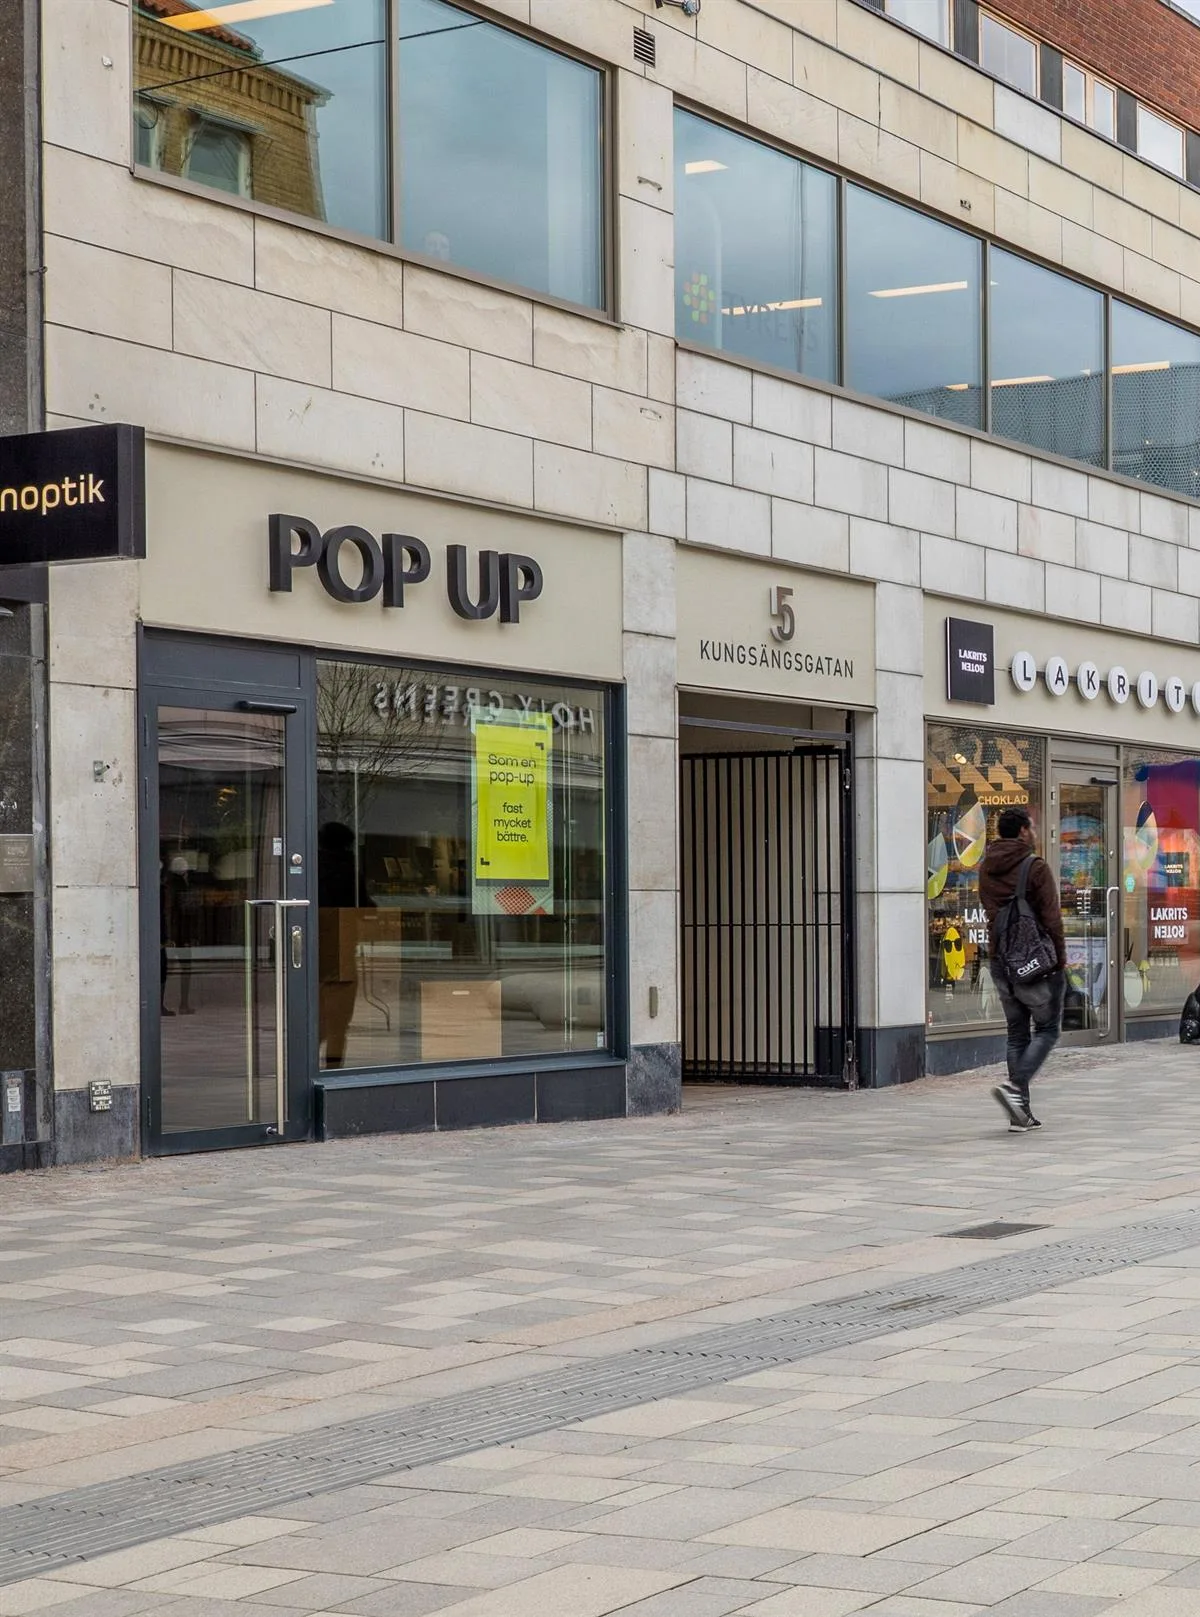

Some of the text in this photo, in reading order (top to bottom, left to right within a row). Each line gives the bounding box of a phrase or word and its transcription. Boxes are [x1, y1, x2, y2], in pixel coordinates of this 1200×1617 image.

[0, 473, 105, 516] noptik
[268, 513, 543, 624] POP UP
[769, 584, 796, 641] 5
[700, 639, 854, 679] KUNGSÄNGSGATAN
[958, 648, 987, 662] LAKRITS
[488, 753, 537, 769] Som en
[489, 770, 535, 788] pop-up
[978, 795, 1029, 806] CHOKLAD
[502, 802, 523, 814] fast
[493, 817, 532, 830] mycket
[496, 831, 529, 843] bättre.
[1151, 907, 1188, 921] LAKRITS
[1154, 925, 1185, 939] ROTEN
